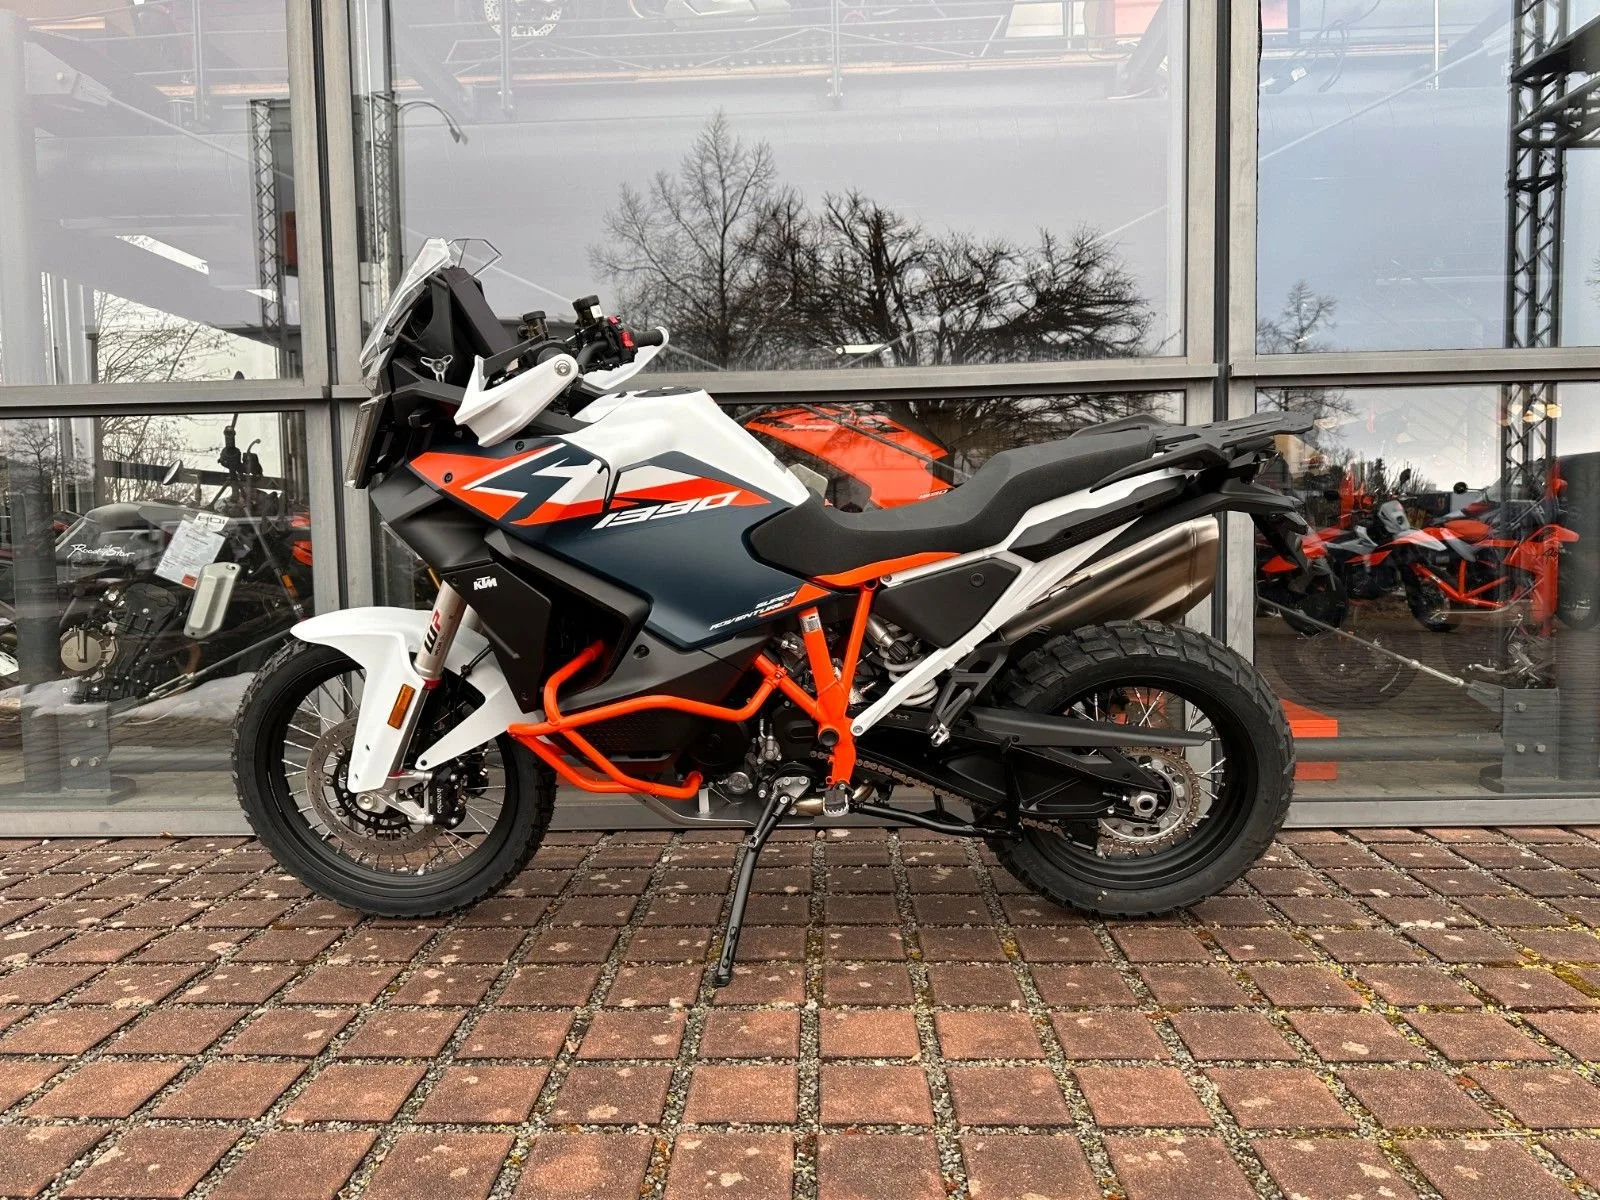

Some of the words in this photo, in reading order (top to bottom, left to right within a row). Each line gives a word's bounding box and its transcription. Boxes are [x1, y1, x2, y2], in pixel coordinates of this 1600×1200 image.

[591, 489, 742, 530] 1390
[473, 576, 498, 591] KTM
[424, 609, 441, 655] WP
[709, 602, 786, 631] ADVENTURE
